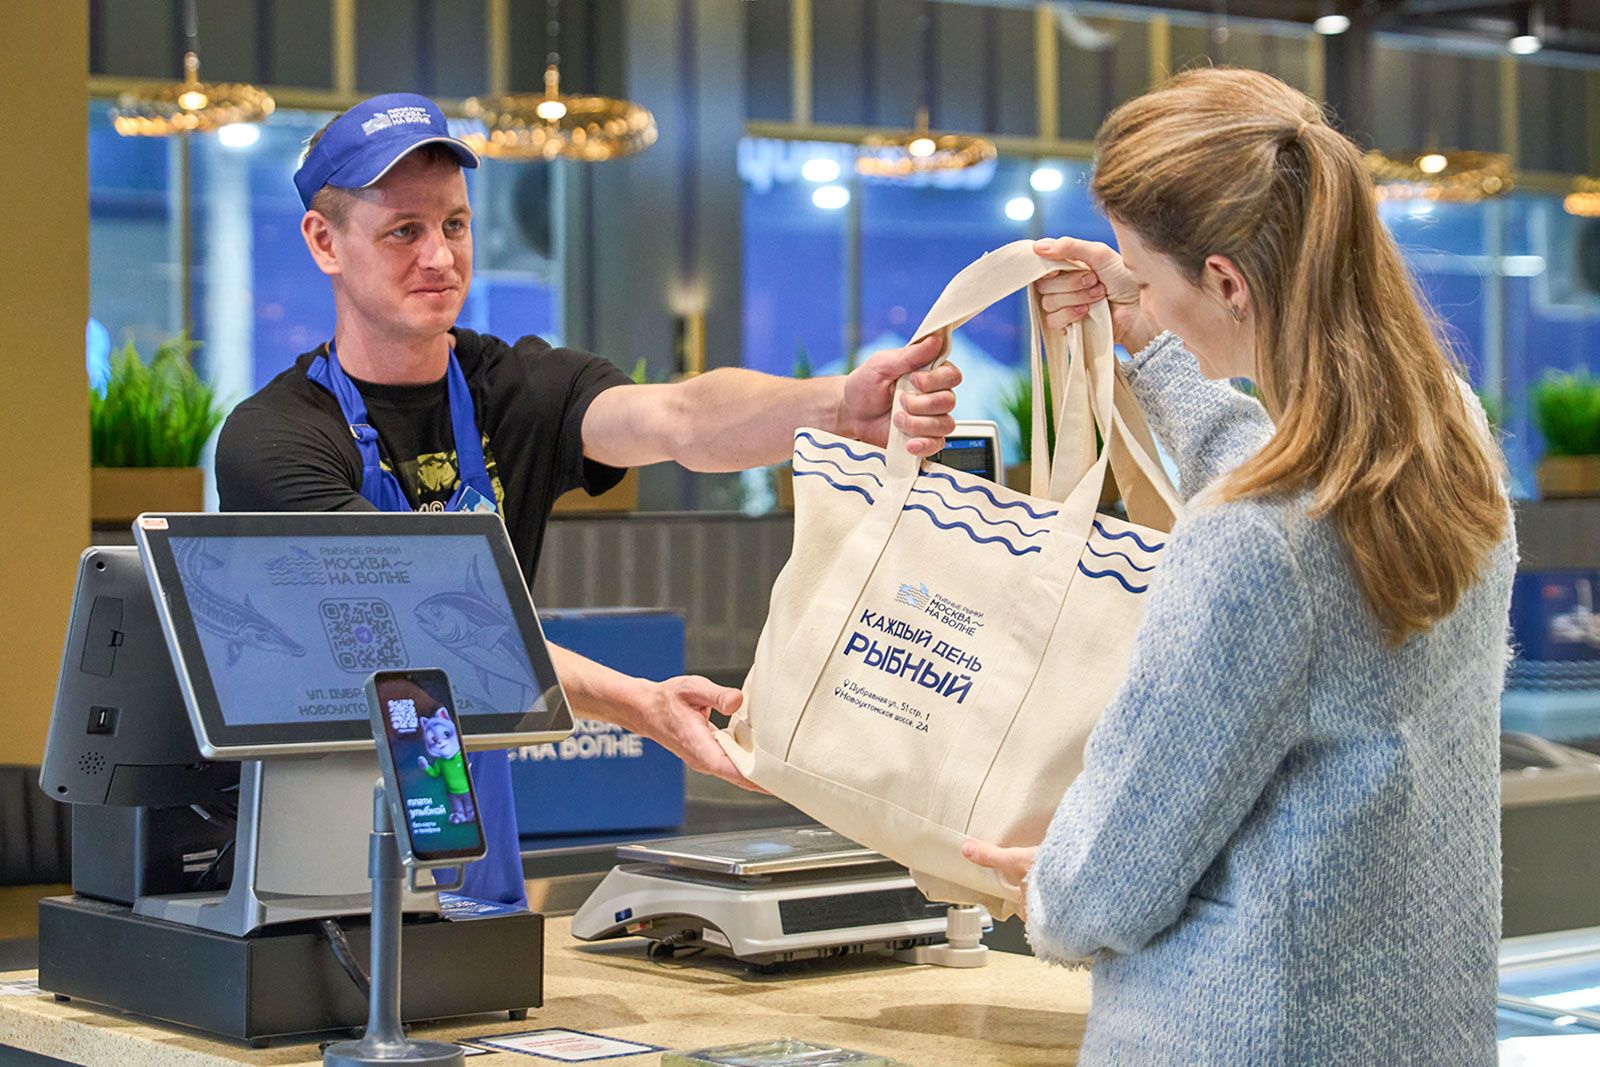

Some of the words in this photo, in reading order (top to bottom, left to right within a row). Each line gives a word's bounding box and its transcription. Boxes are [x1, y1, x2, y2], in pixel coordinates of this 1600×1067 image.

[323, 557, 393, 571] МОСКВА
[328, 571, 354, 585] НА
[355, 570, 411, 585] ВОЛНЕ
[924, 607, 940, 621] НА
[940, 614, 977, 637] ВОЛНЕ
[929, 599, 971, 625] МОСКВА
[859, 609, 933, 648] КАЖДЫЙ
[931, 640, 982, 673] ДЕНЬ
[843, 631, 974, 704] РЫБНЫЙ
[329, 687, 366, 700] ДУБР
[298, 702, 369, 716] НОВОУХТО
[558, 734, 644, 760] ВОЛНЕ
